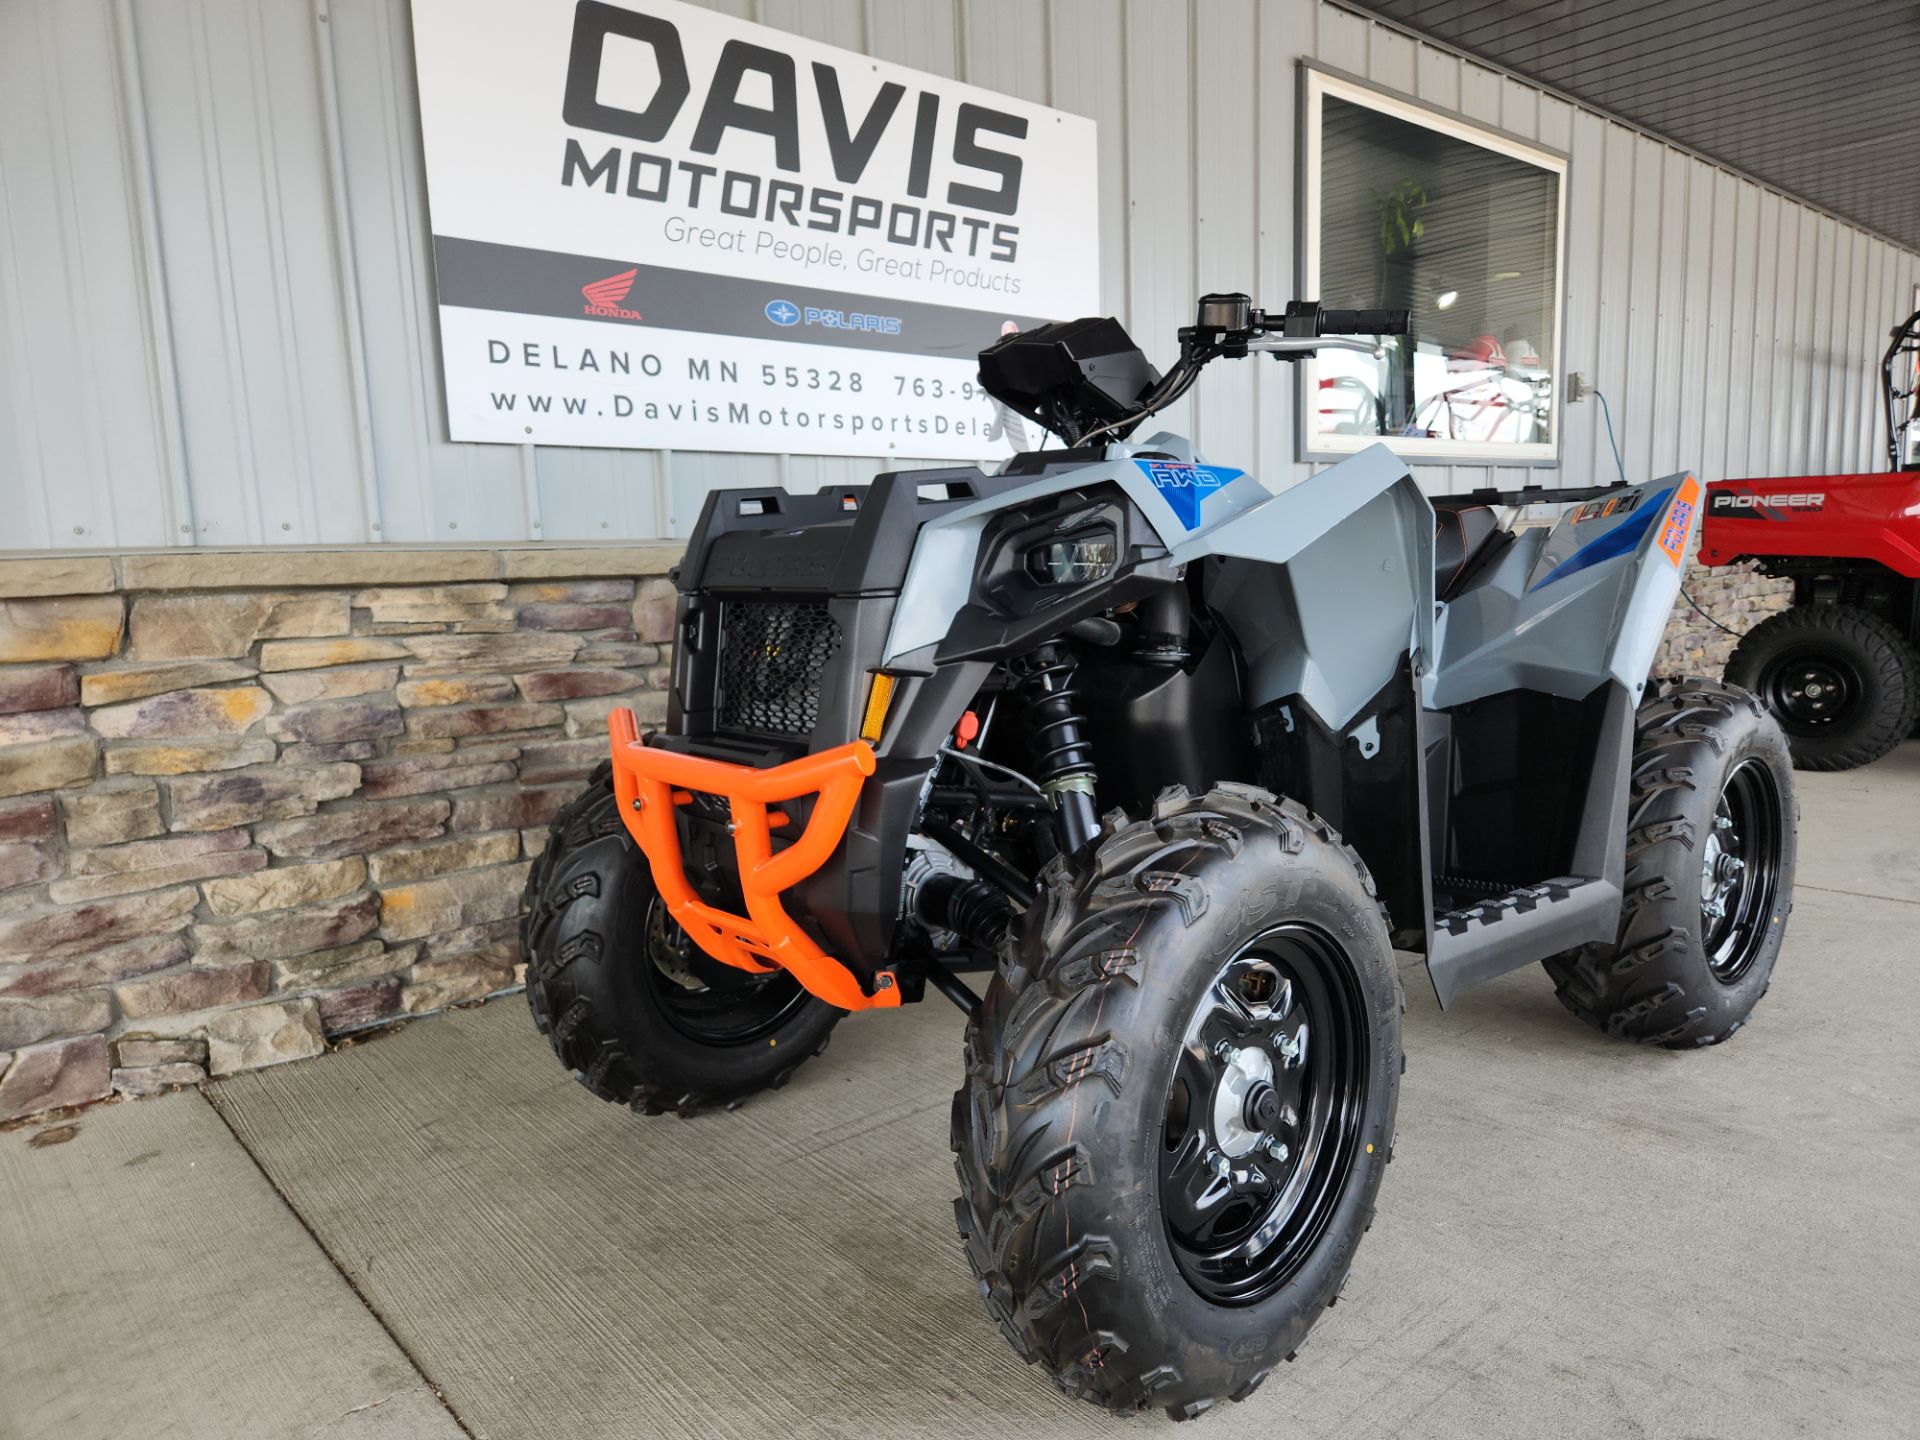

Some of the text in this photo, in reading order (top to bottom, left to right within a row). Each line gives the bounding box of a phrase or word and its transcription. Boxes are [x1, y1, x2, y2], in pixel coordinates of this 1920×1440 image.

[562, 0, 1029, 216] DAVIS
[561, 138, 1020, 263] MOTORSPORTS
[663, 216, 1022, 295] Great People, Great Products
[583, 305, 642, 321] HONDA
[804, 307, 902, 335] POLARIS
[488, 339, 987, 402] DELANO MN 55328 763-9
[1149, 468, 1222, 489] AWD
[1714, 493, 1825, 508] PIONEER
